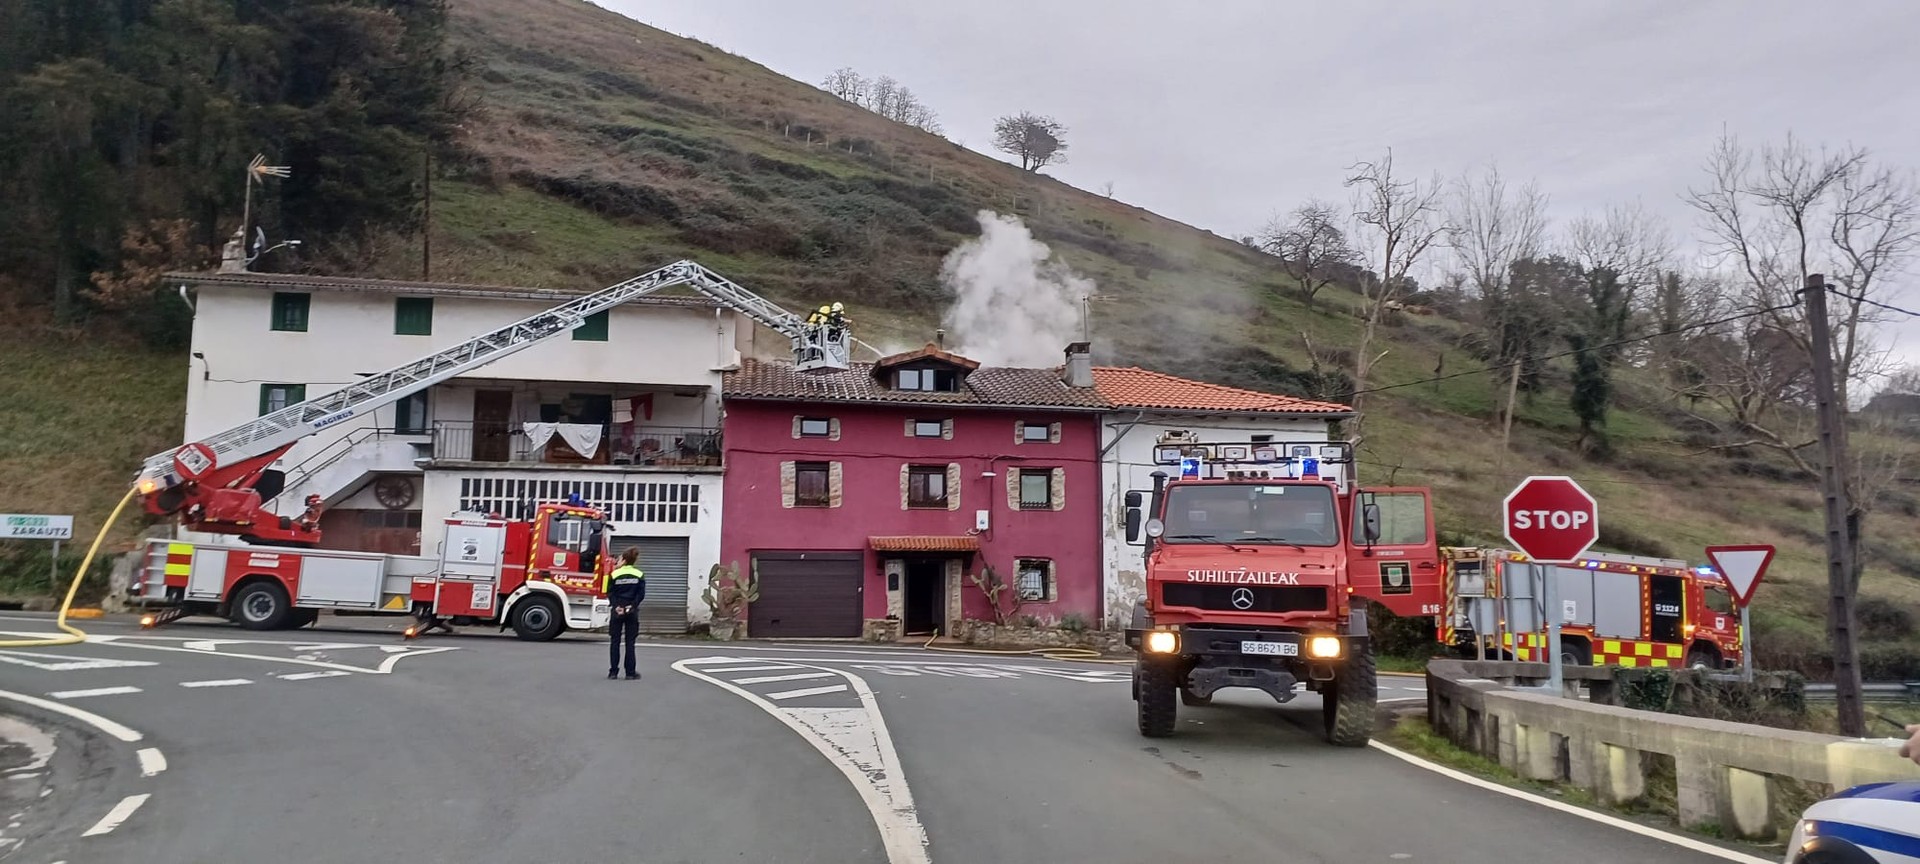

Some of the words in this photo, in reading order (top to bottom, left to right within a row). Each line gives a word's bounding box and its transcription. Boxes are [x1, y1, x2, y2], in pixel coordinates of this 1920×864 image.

[314, 410, 354, 428] MAGIRUS
[1514, 510, 1589, 530] STOP
[12, 527, 68, 536] ZARAUTZ
[1421, 604, 1440, 614] 8.16
